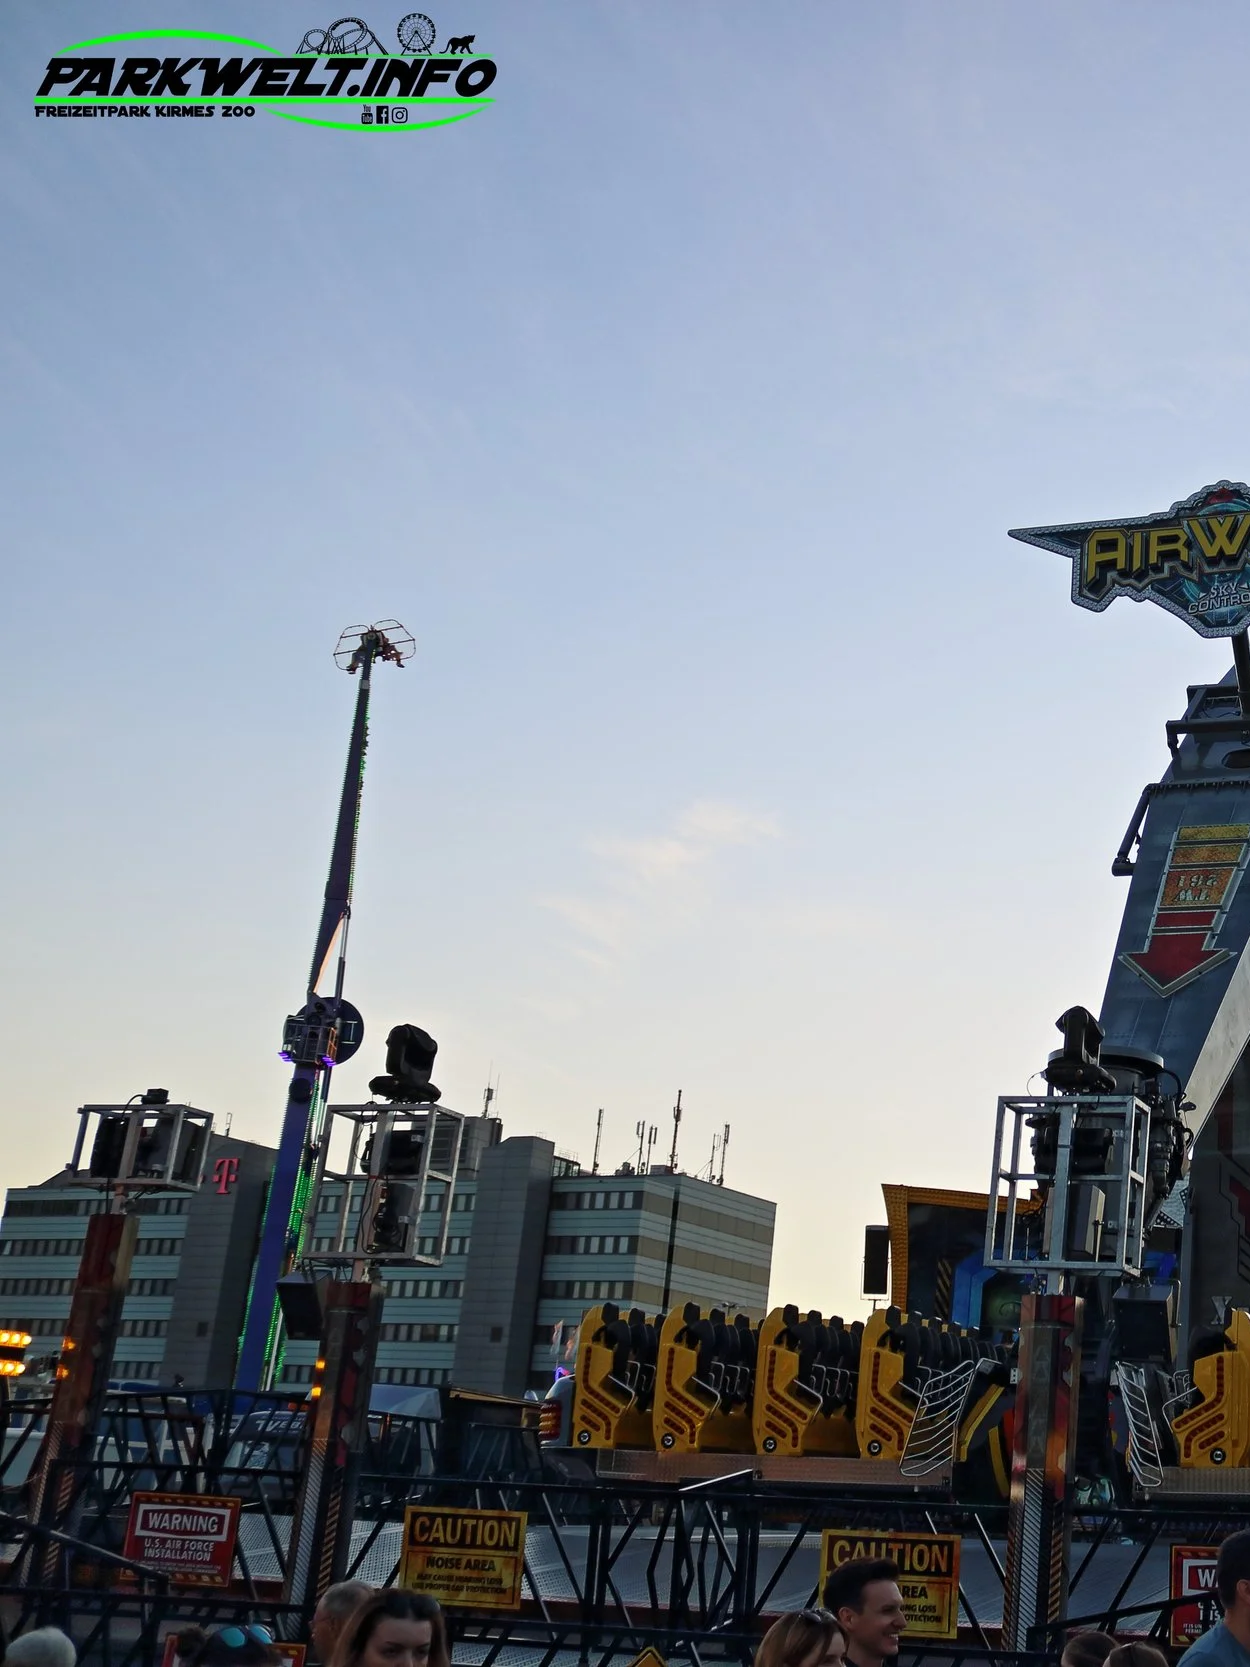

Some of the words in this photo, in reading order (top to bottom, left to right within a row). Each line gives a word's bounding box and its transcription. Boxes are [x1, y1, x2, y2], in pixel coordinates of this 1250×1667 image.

[1210, 582, 1239, 598] SKY
[148, 1512, 219, 1533] WARNING
[413, 1515, 516, 1547] CAUTION
[144, 1537, 163, 1548] U.S.
[165, 1540, 181, 1549] AIR
[184, 1540, 215, 1551] FORCE
[143, 1548, 211, 1561] INSTALLATION
[426, 1556, 461, 1570] NOISE
[464, 1557, 496, 1571] AREA
[900, 1585, 928, 1599] REA
[918, 1604, 937, 1613] LOSS
